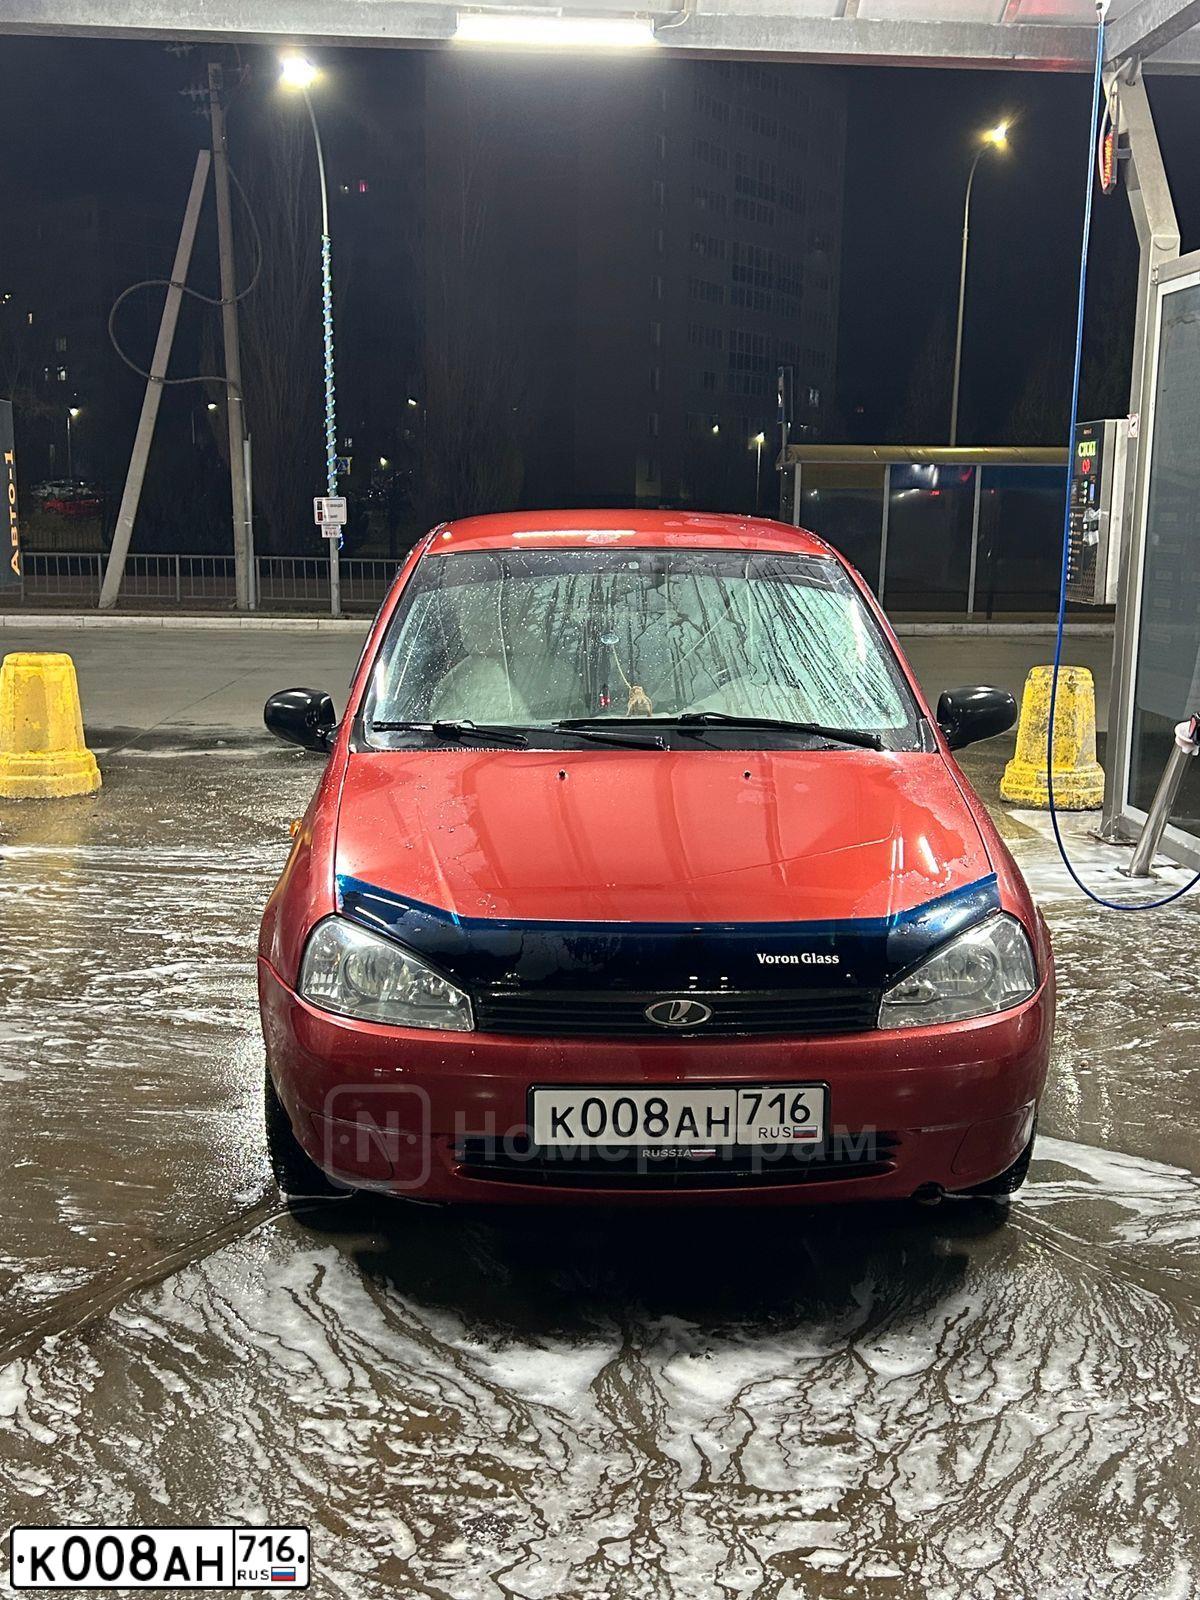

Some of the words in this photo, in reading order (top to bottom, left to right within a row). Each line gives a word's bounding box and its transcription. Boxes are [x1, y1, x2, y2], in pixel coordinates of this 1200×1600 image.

[4, 449, 20, 576] АВТО-1
[756, 953, 799, 964] Voron
[801, 952, 840, 964] Glass
[742, 1092, 811, 1125] 716
[758, 1126, 792, 1139] RUS
[642, 1149, 692, 1158] RUSSIA
